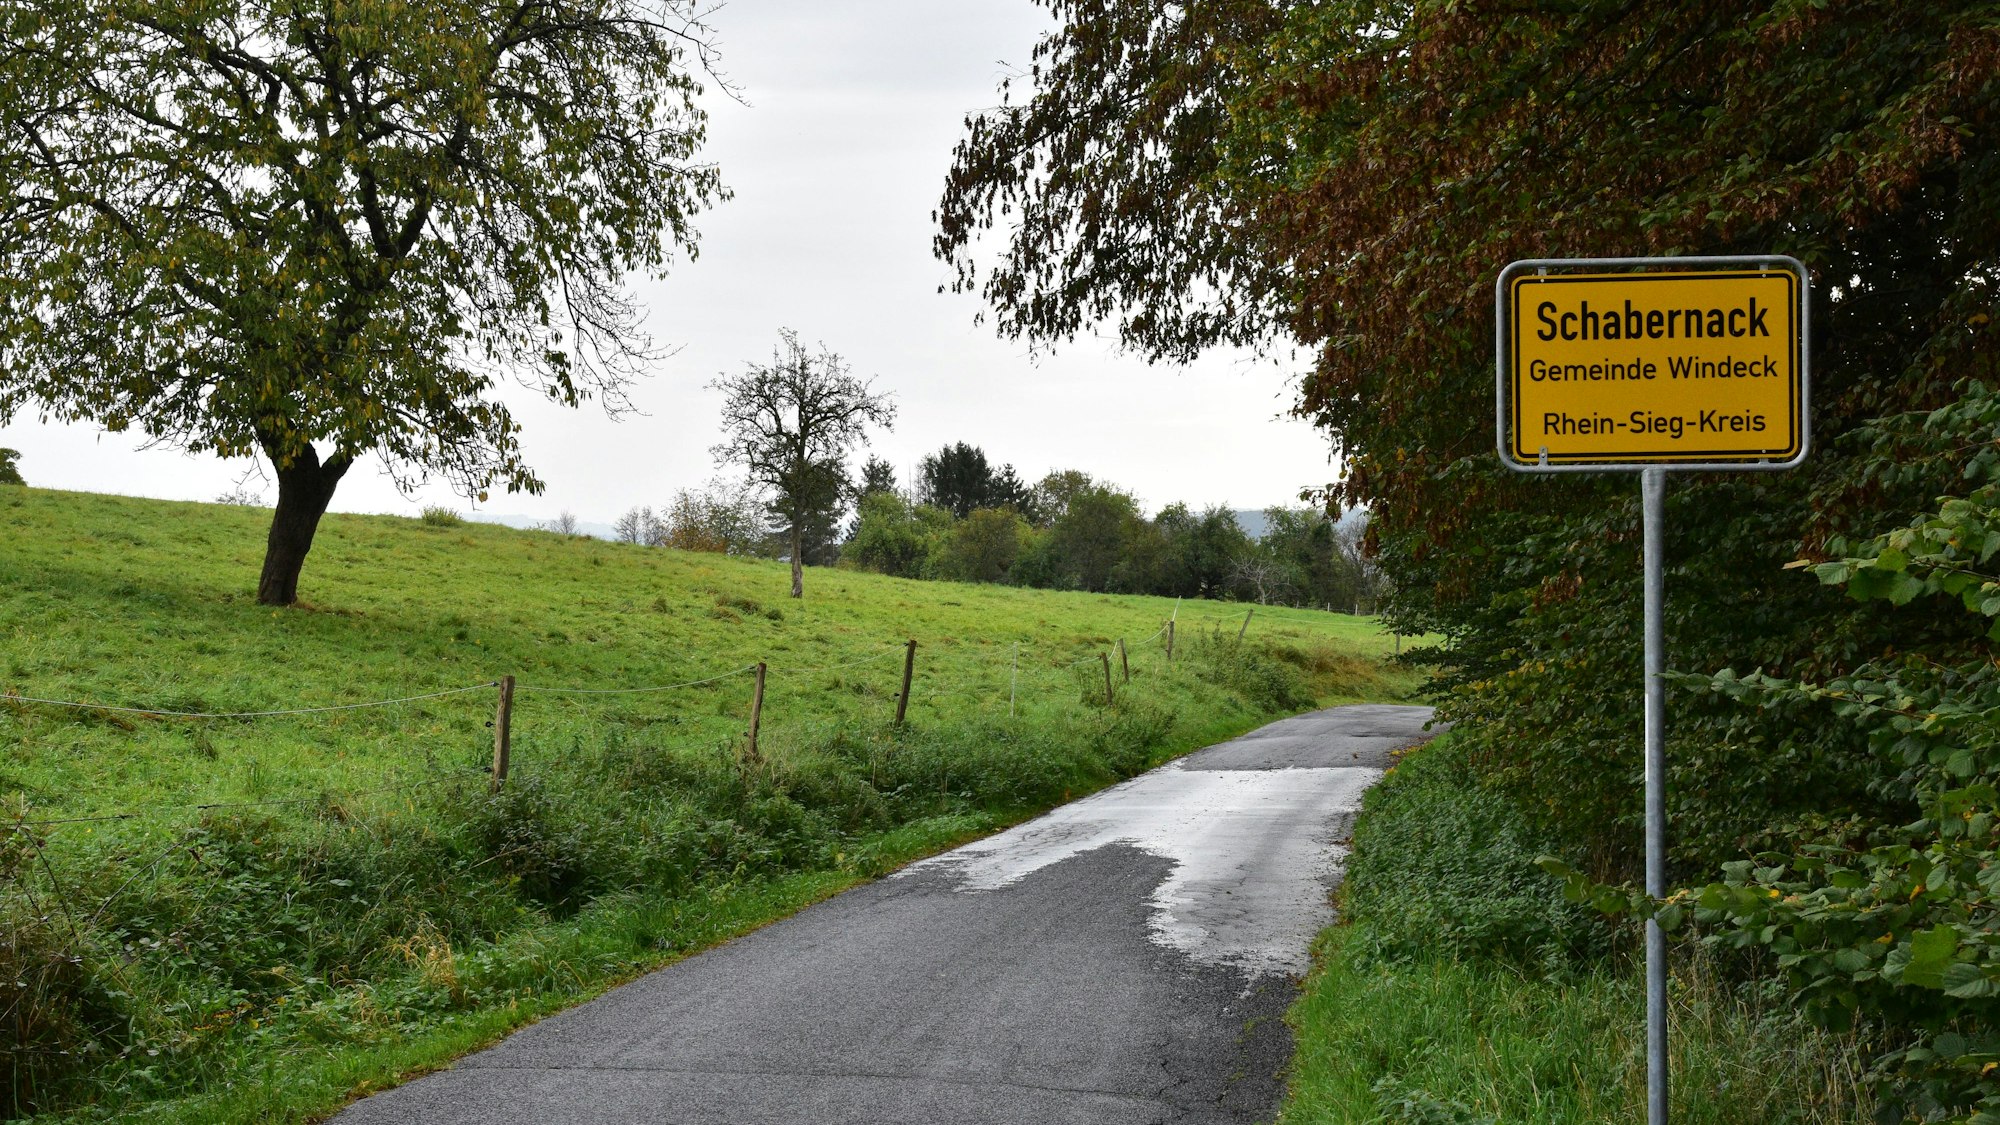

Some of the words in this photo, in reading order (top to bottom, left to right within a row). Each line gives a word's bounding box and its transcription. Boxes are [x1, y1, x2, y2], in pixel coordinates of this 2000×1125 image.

[1537, 297, 1770, 341] Schabernack
[1530, 358, 1657, 382] Gemeinde
[1668, 355, 1778, 380] Windeck
[1543, 410, 1766, 439] Rhein-Sieg-Kreis
